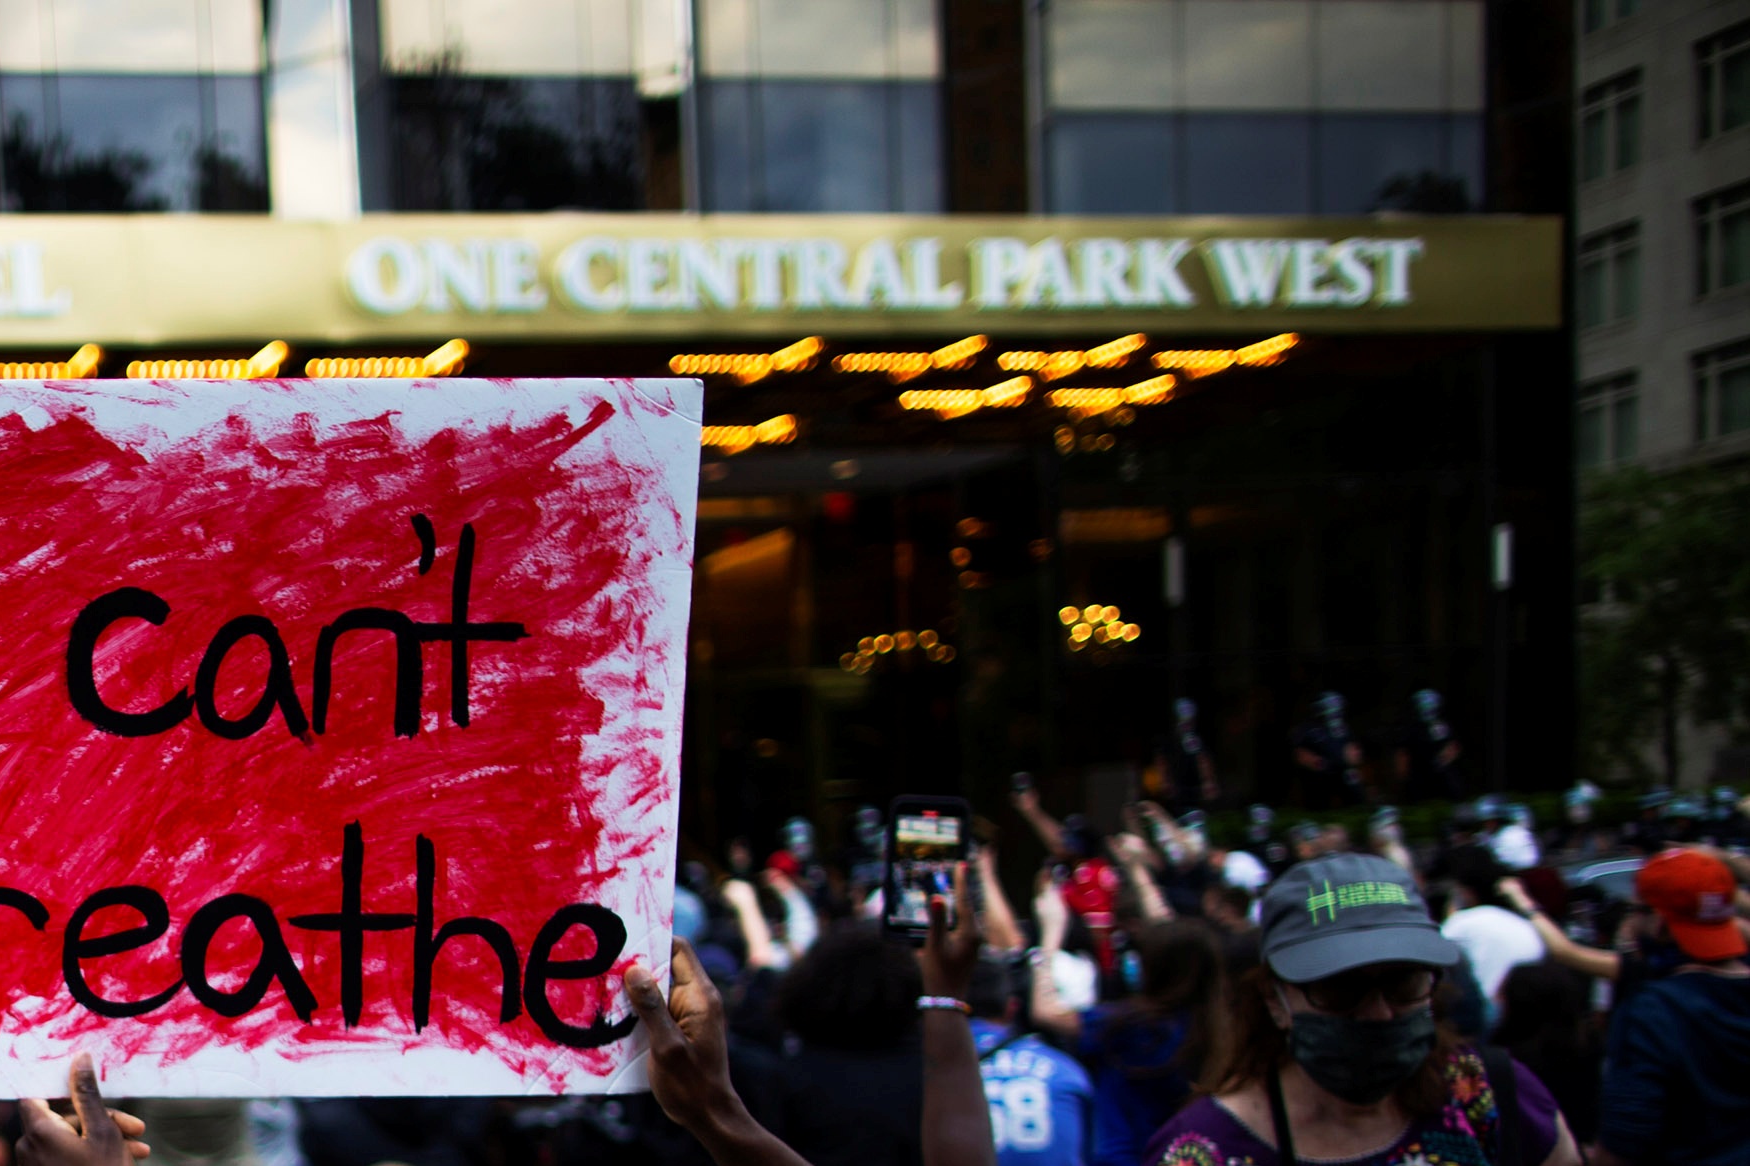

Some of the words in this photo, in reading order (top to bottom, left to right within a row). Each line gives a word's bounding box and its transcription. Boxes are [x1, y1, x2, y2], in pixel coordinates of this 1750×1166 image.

[345, 237, 549, 316] ONE
[556, 236, 962, 314] CENTRAL
[970, 237, 1200, 312] PARK
[1202, 237, 1424, 308] WEST
[65, 514, 531, 744] can't
